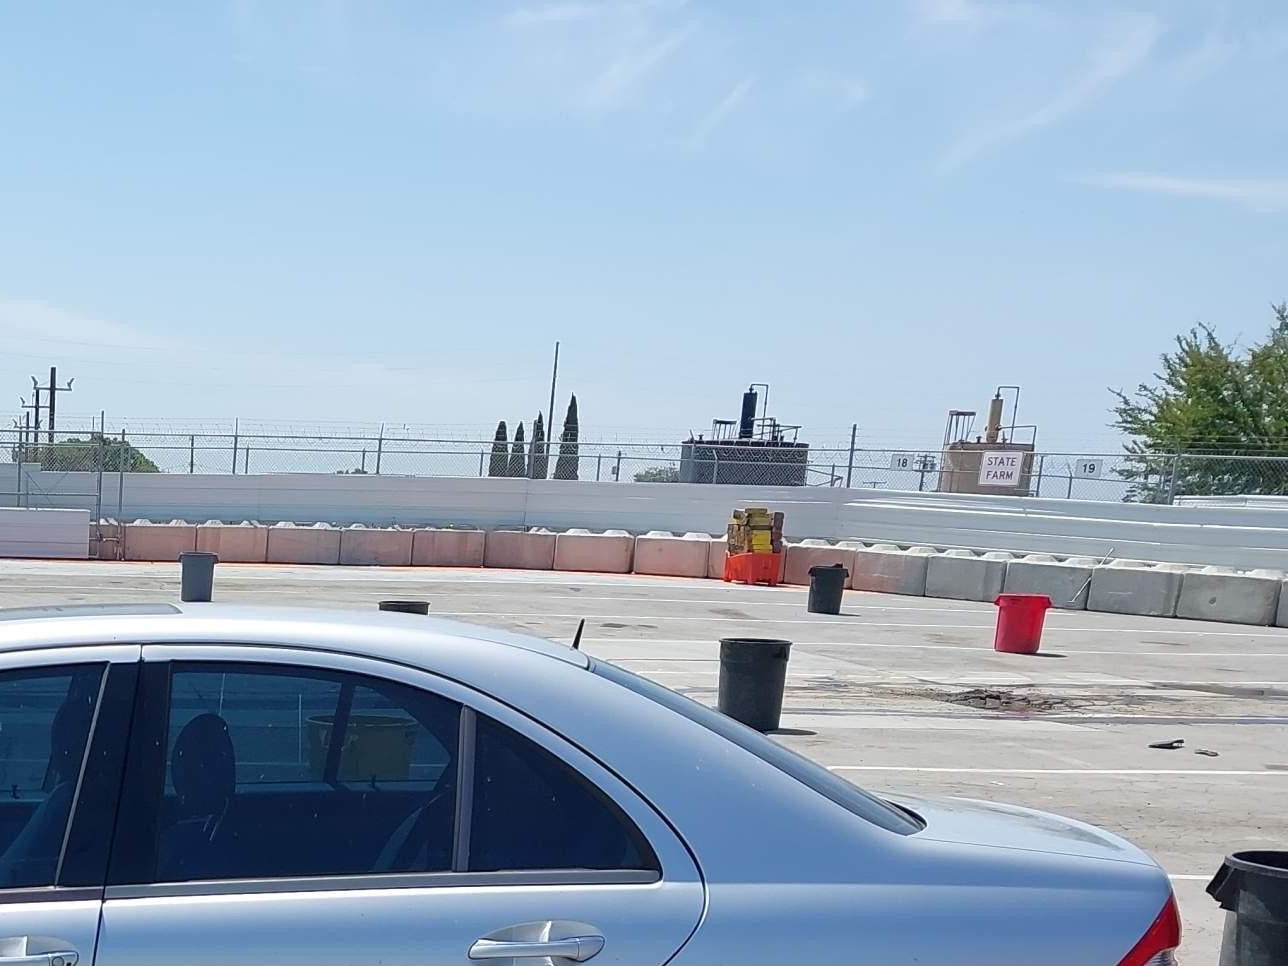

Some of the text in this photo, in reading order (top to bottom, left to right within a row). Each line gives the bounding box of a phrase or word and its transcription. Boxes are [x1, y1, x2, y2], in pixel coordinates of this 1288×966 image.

[897, 458, 908, 468] 18
[986, 456, 1017, 467] STATE
[1083, 463, 1096, 473] 19
[985, 470, 1014, 481] FARM
